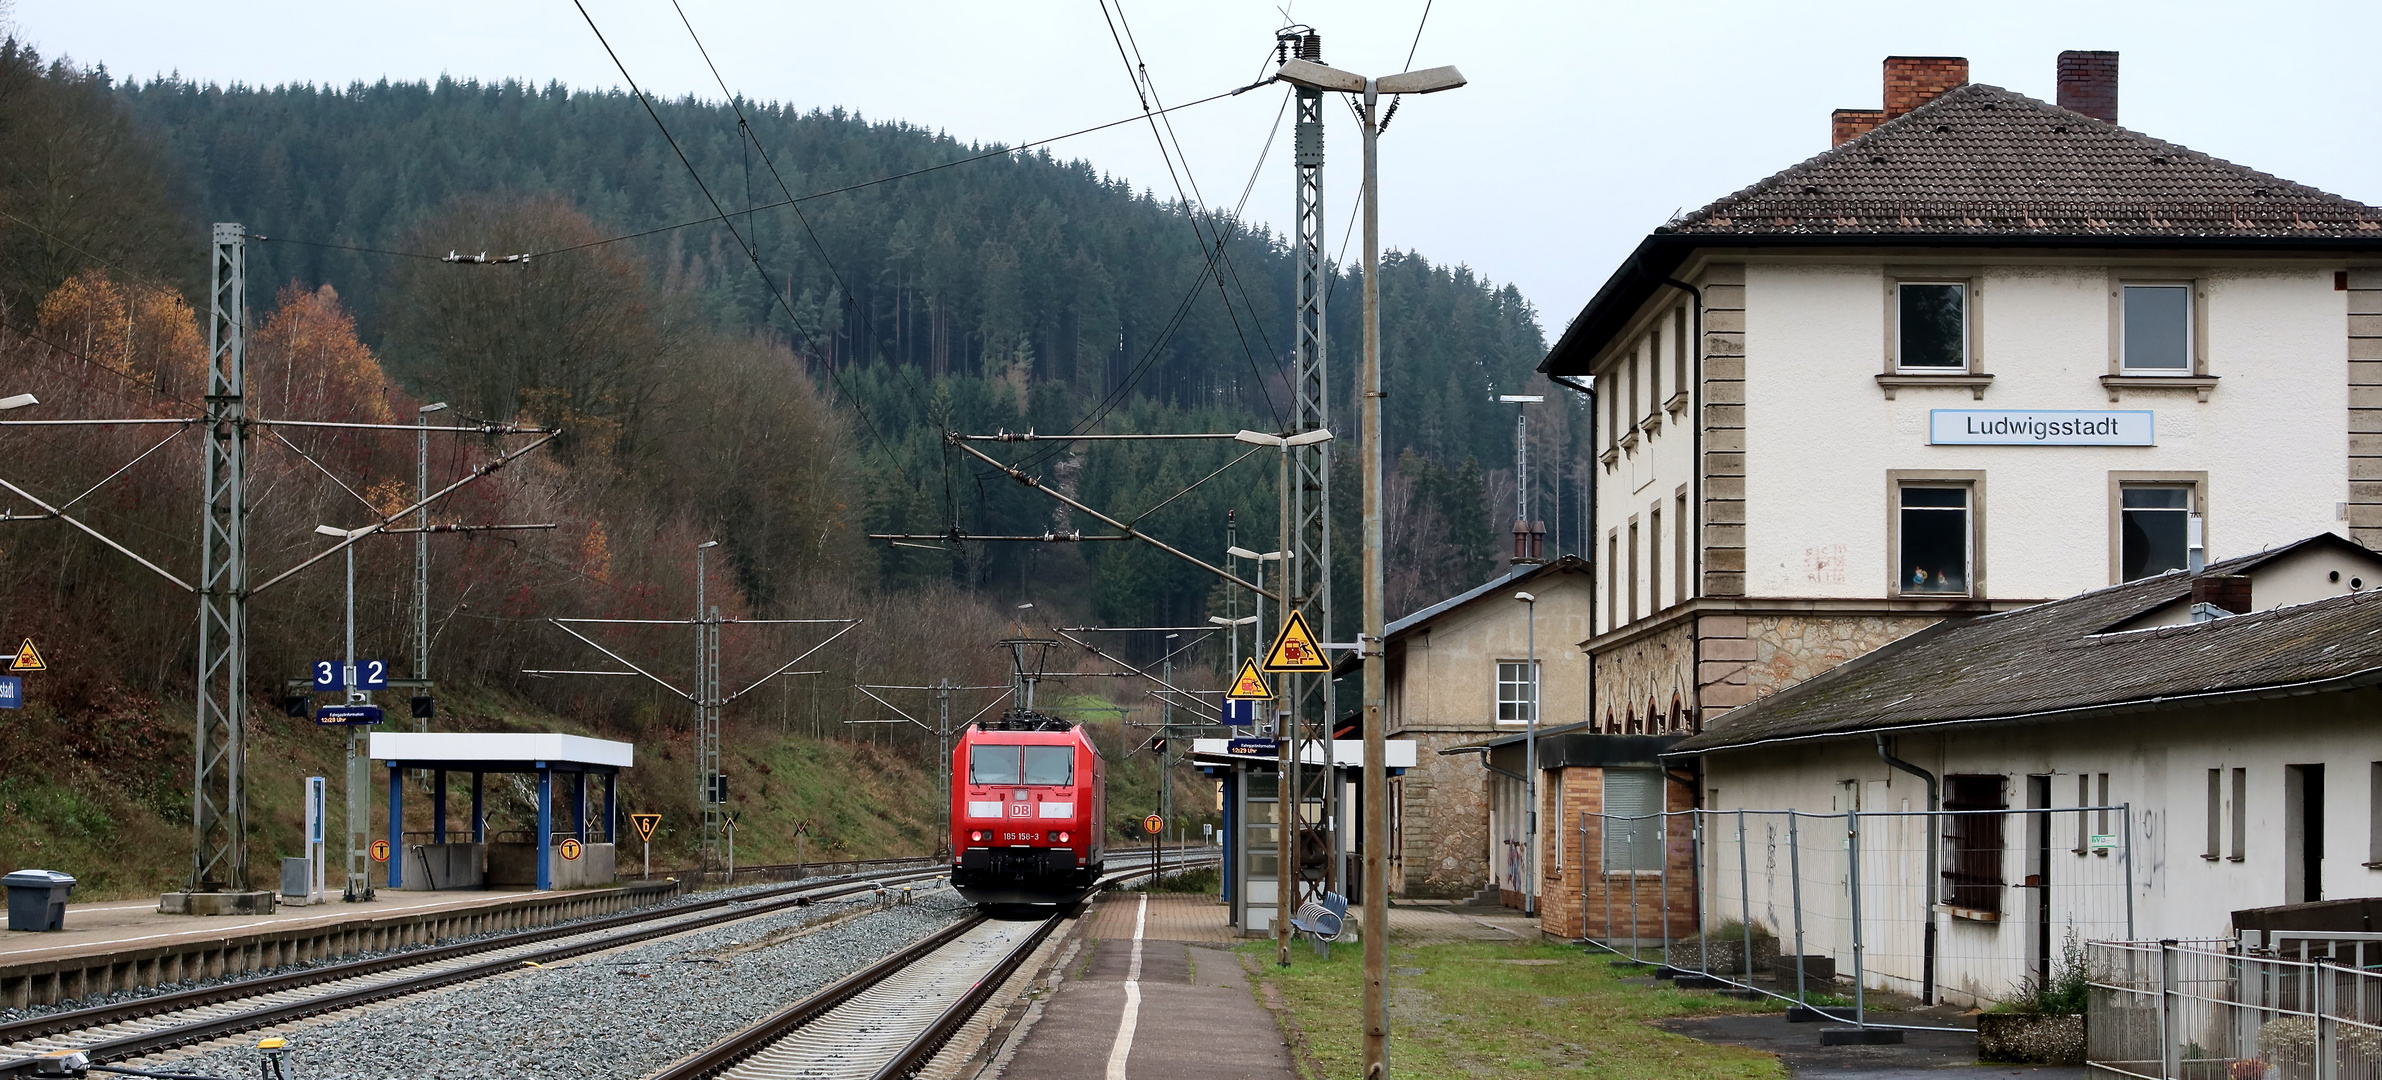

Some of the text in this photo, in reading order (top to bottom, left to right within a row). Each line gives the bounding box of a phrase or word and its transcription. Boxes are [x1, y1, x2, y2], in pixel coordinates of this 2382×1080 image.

[1967, 416, 2119, 441] Ludwigsstadt
[317, 661, 333, 685] 3
[368, 660, 384, 684] 2
[1226, 699, 1236, 718] 1
[1012, 805, 1030, 816] DB
[642, 818, 650, 832] 6
[1003, 832, 1040, 841] 185 158-3
